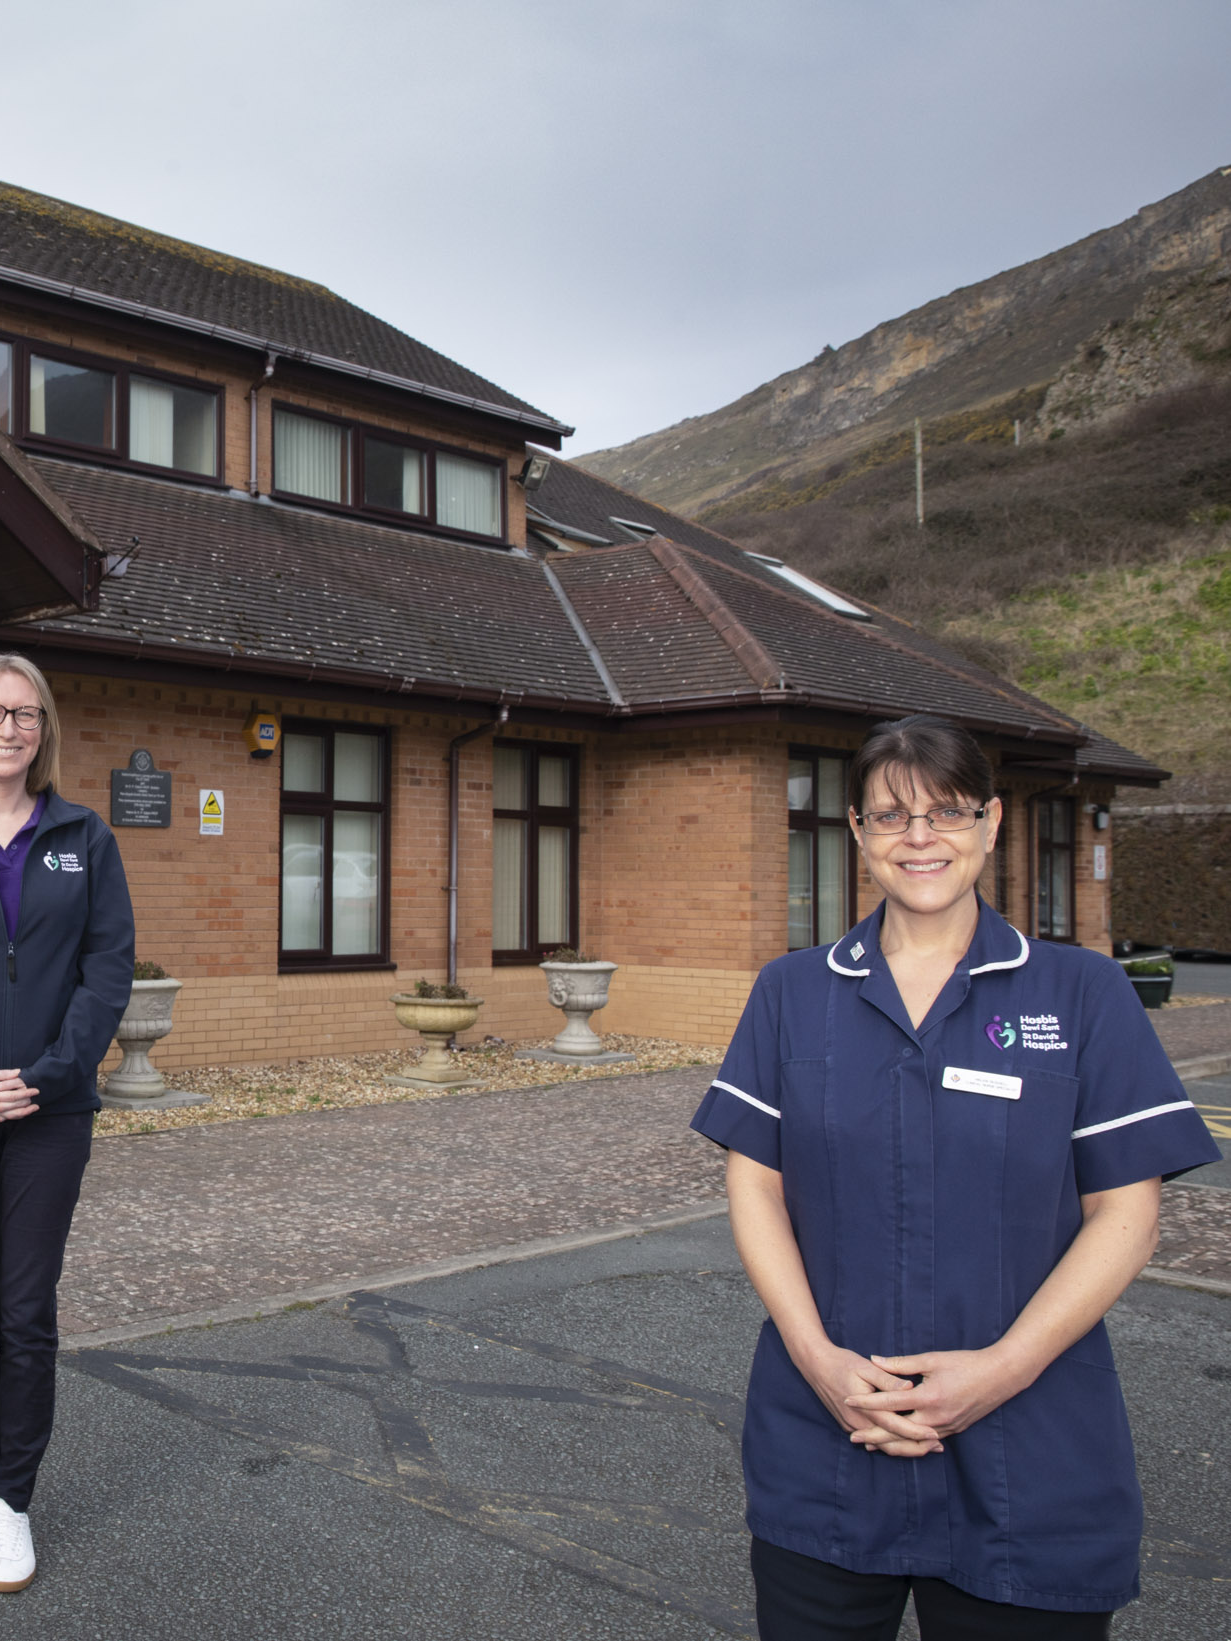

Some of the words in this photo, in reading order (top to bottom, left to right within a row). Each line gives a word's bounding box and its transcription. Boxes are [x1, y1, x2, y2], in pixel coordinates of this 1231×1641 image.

[260, 727, 274, 738] ADT
[1020, 1014, 1059, 1024] Hosbis
[1022, 1032, 1032, 1040] St
[1032, 1032, 1060, 1040] David's
[1022, 1039, 1068, 1051] Hospice
